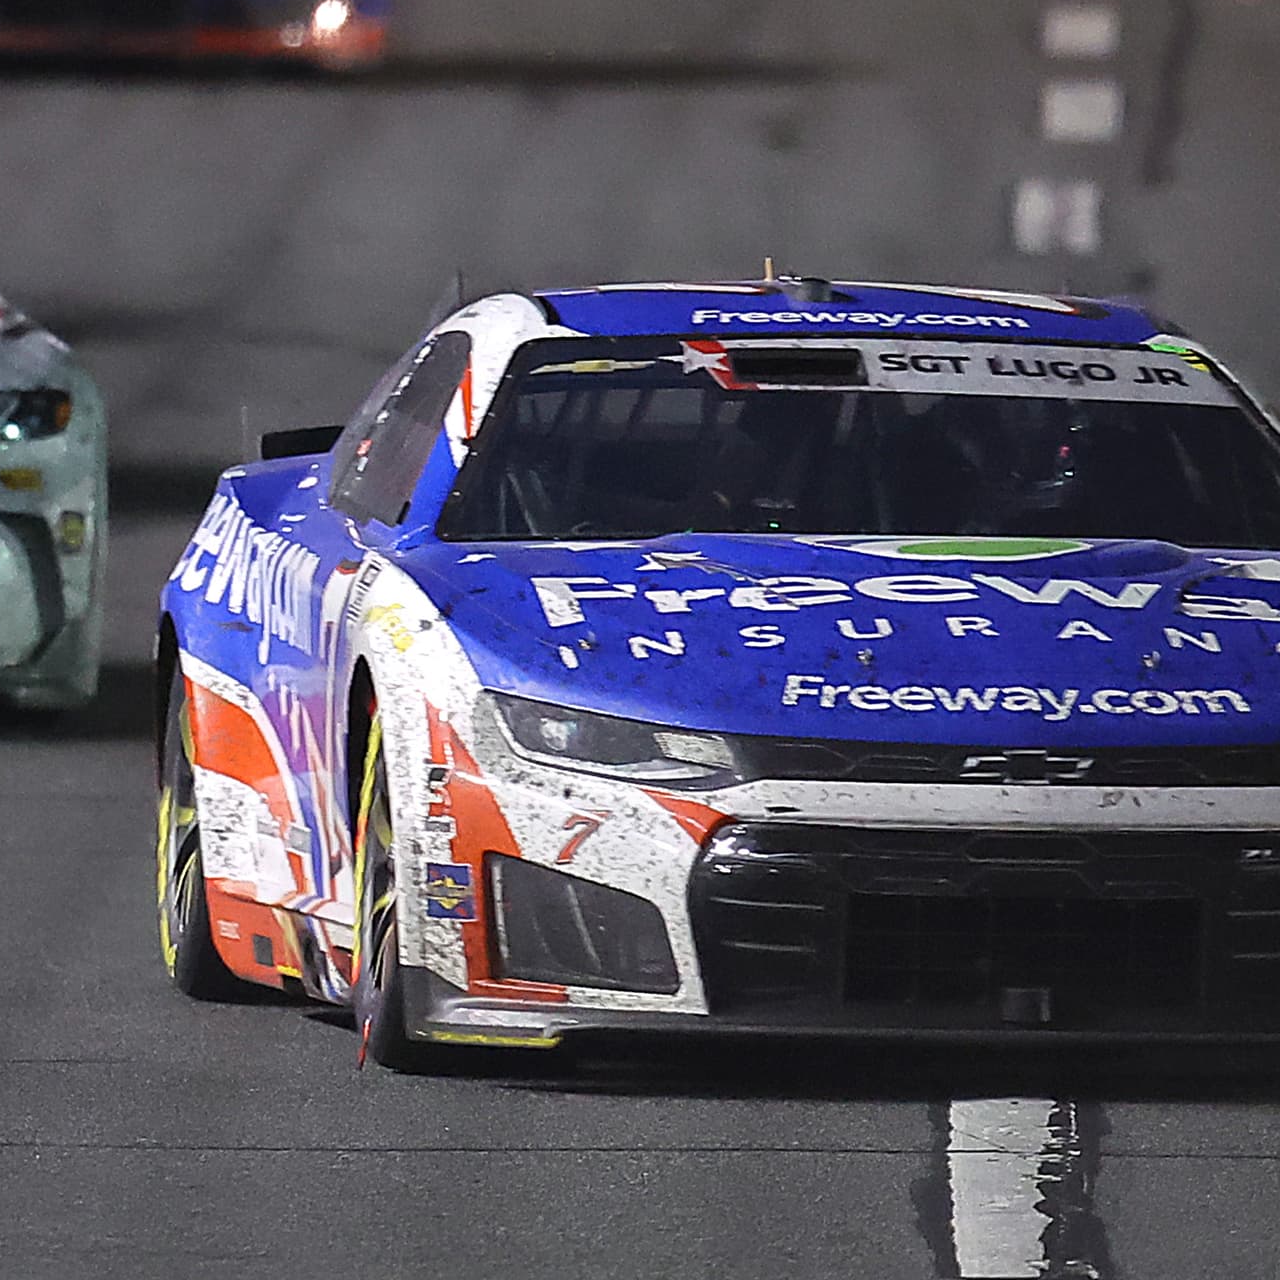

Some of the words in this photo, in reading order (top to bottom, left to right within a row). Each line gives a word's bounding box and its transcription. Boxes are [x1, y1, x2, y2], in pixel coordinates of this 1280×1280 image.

[691, 308, 1030, 328] Freeway.com
[878, 352, 970, 375] SGT
[985, 357, 1116, 382] LUGO
[1133, 365, 1189, 388] JR
[781, 673, 1252, 721] Freeway.com
[556, 808, 613, 865] 7
